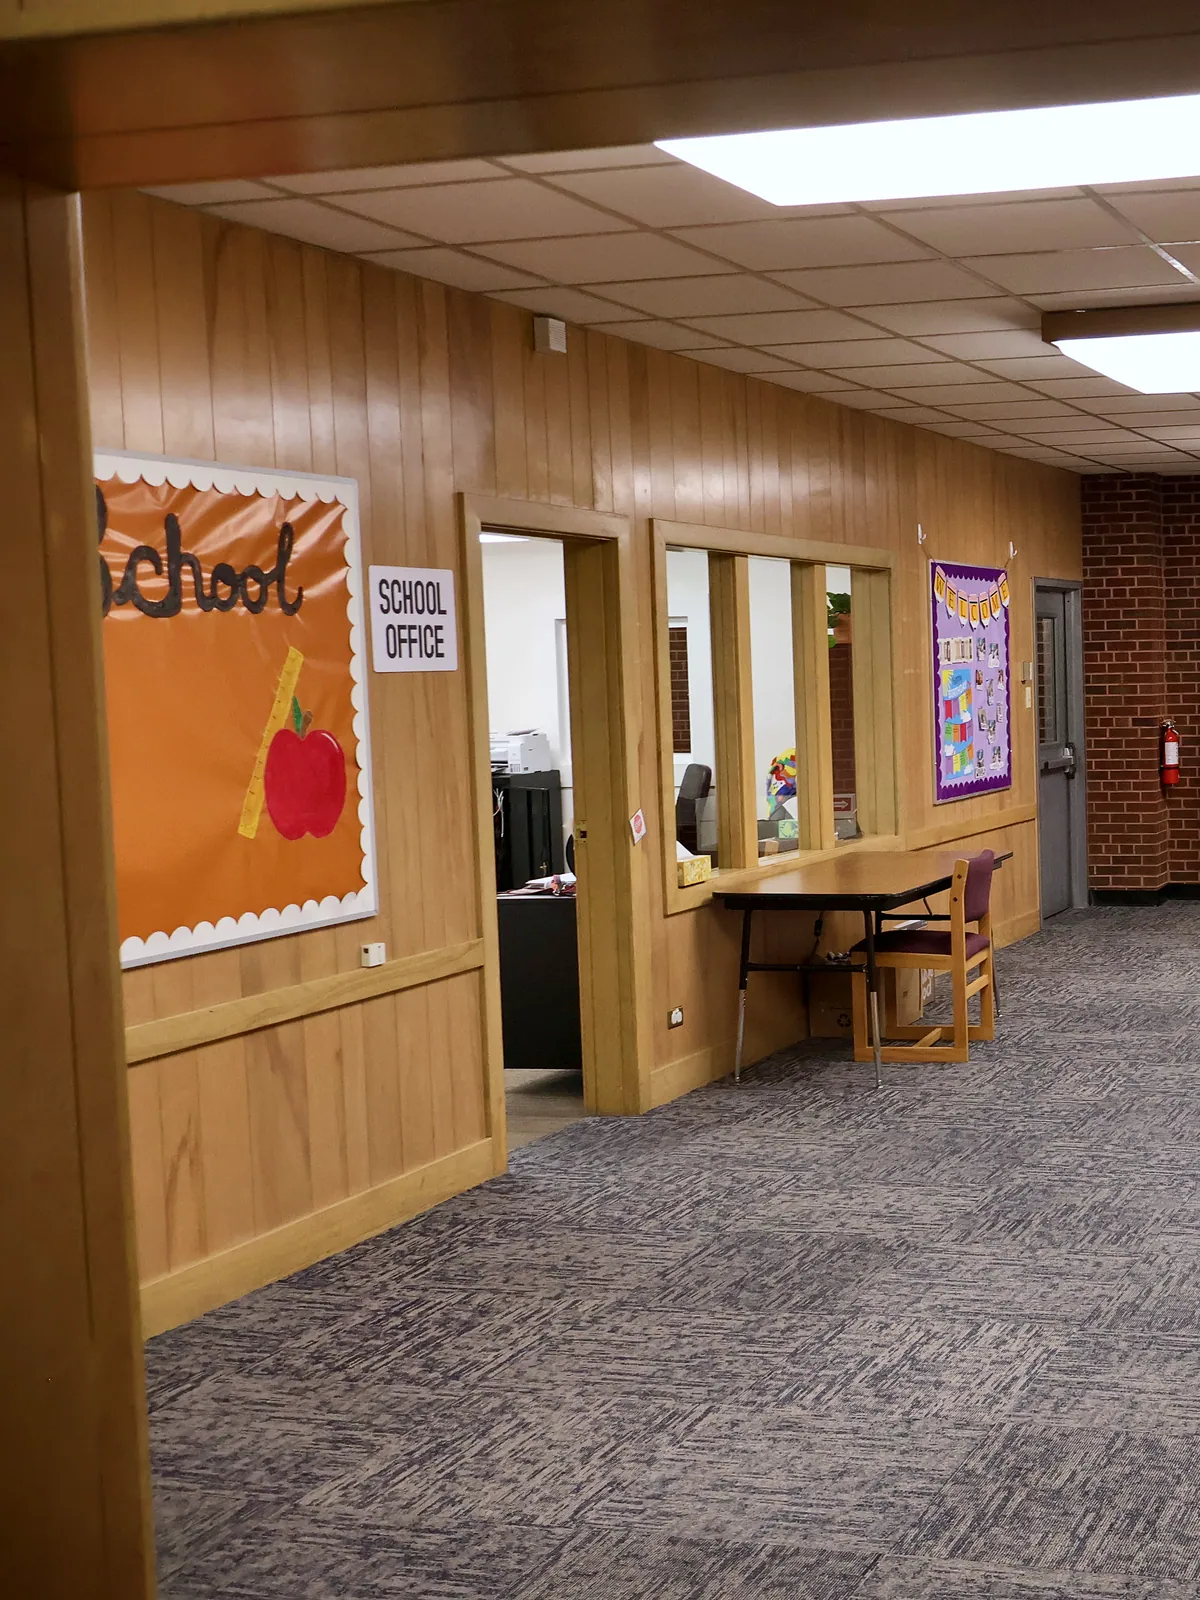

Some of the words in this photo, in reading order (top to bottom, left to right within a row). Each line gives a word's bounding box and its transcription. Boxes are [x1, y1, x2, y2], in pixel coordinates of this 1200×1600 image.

[379, 578, 448, 616] SCHOOL
[936, 574, 1008, 621] WELCOME
[385, 624, 445, 659] OFFICE
